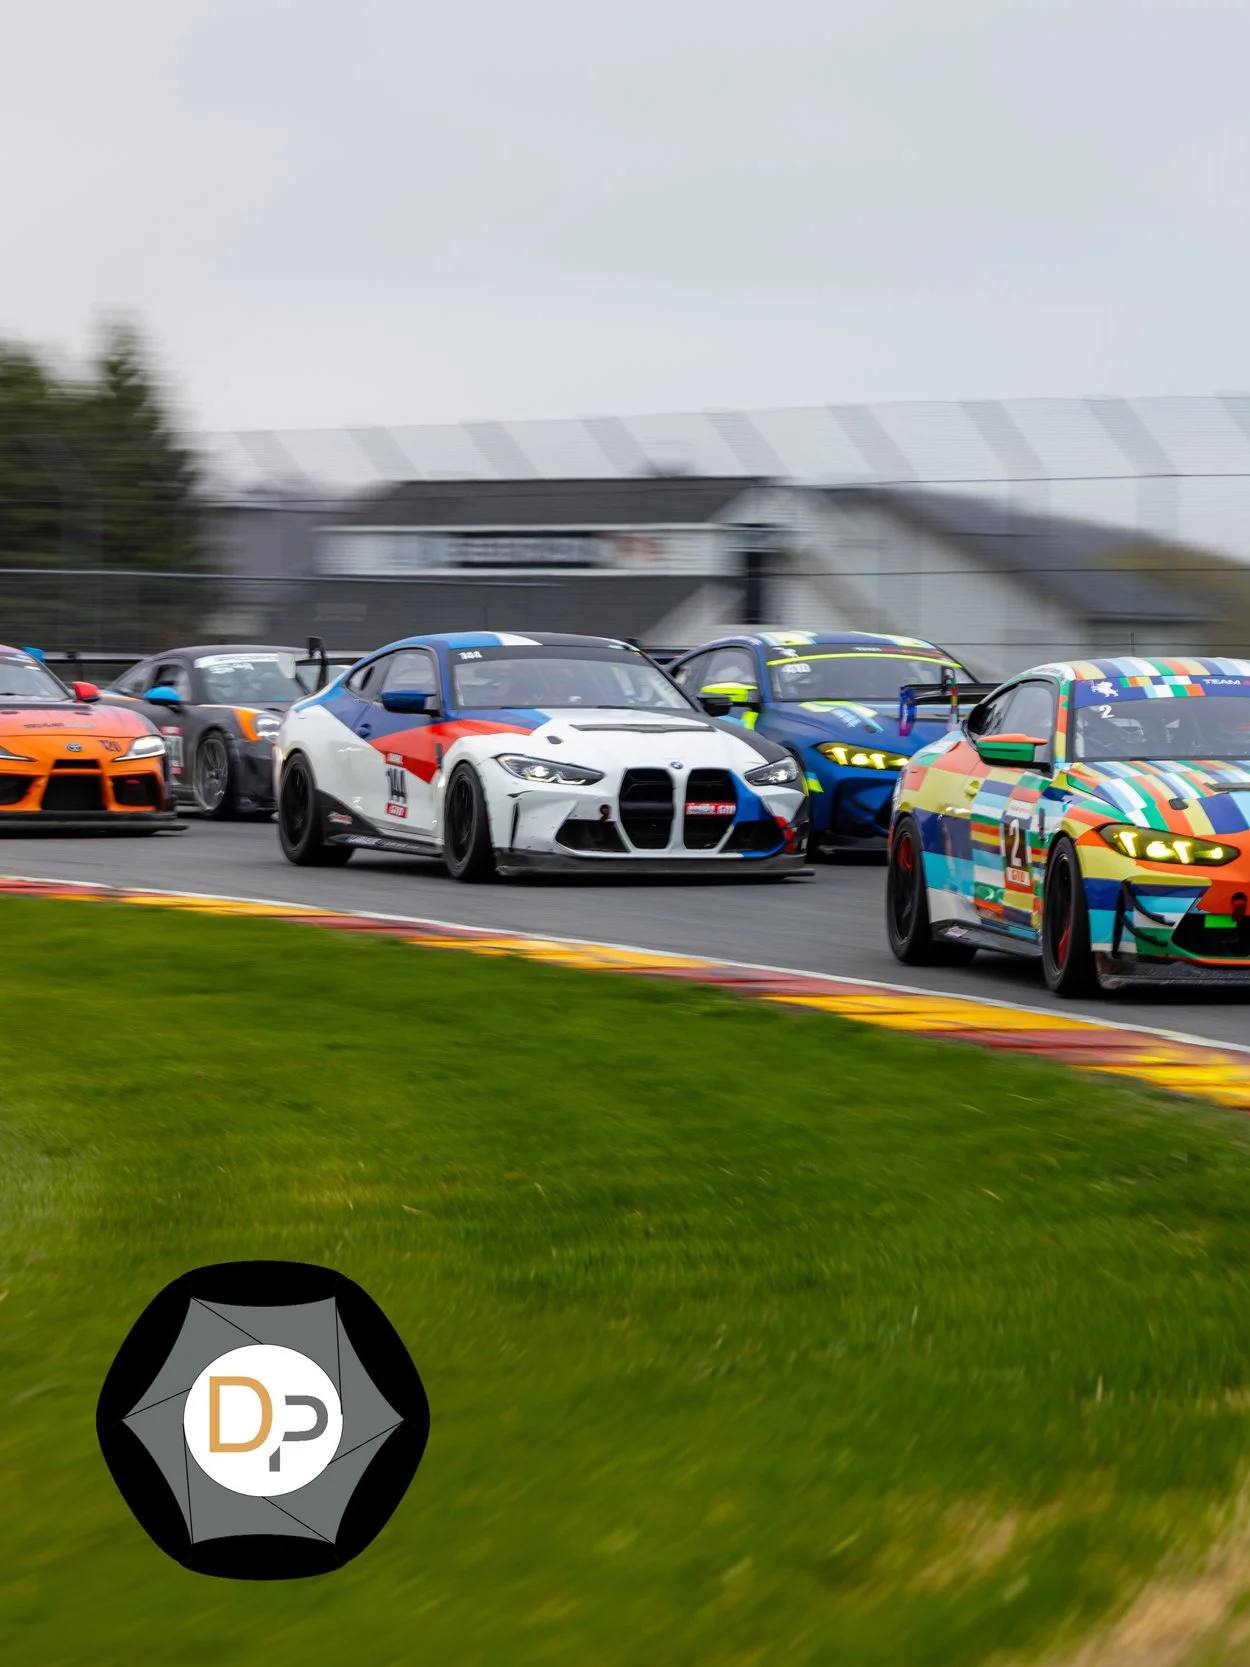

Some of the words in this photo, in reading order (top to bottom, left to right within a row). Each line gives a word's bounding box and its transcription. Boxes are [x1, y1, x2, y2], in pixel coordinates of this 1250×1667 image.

[1099, 704, 1115, 719] 2
[386, 767, 408, 805] 144
[1009, 818, 1023, 868] 2
